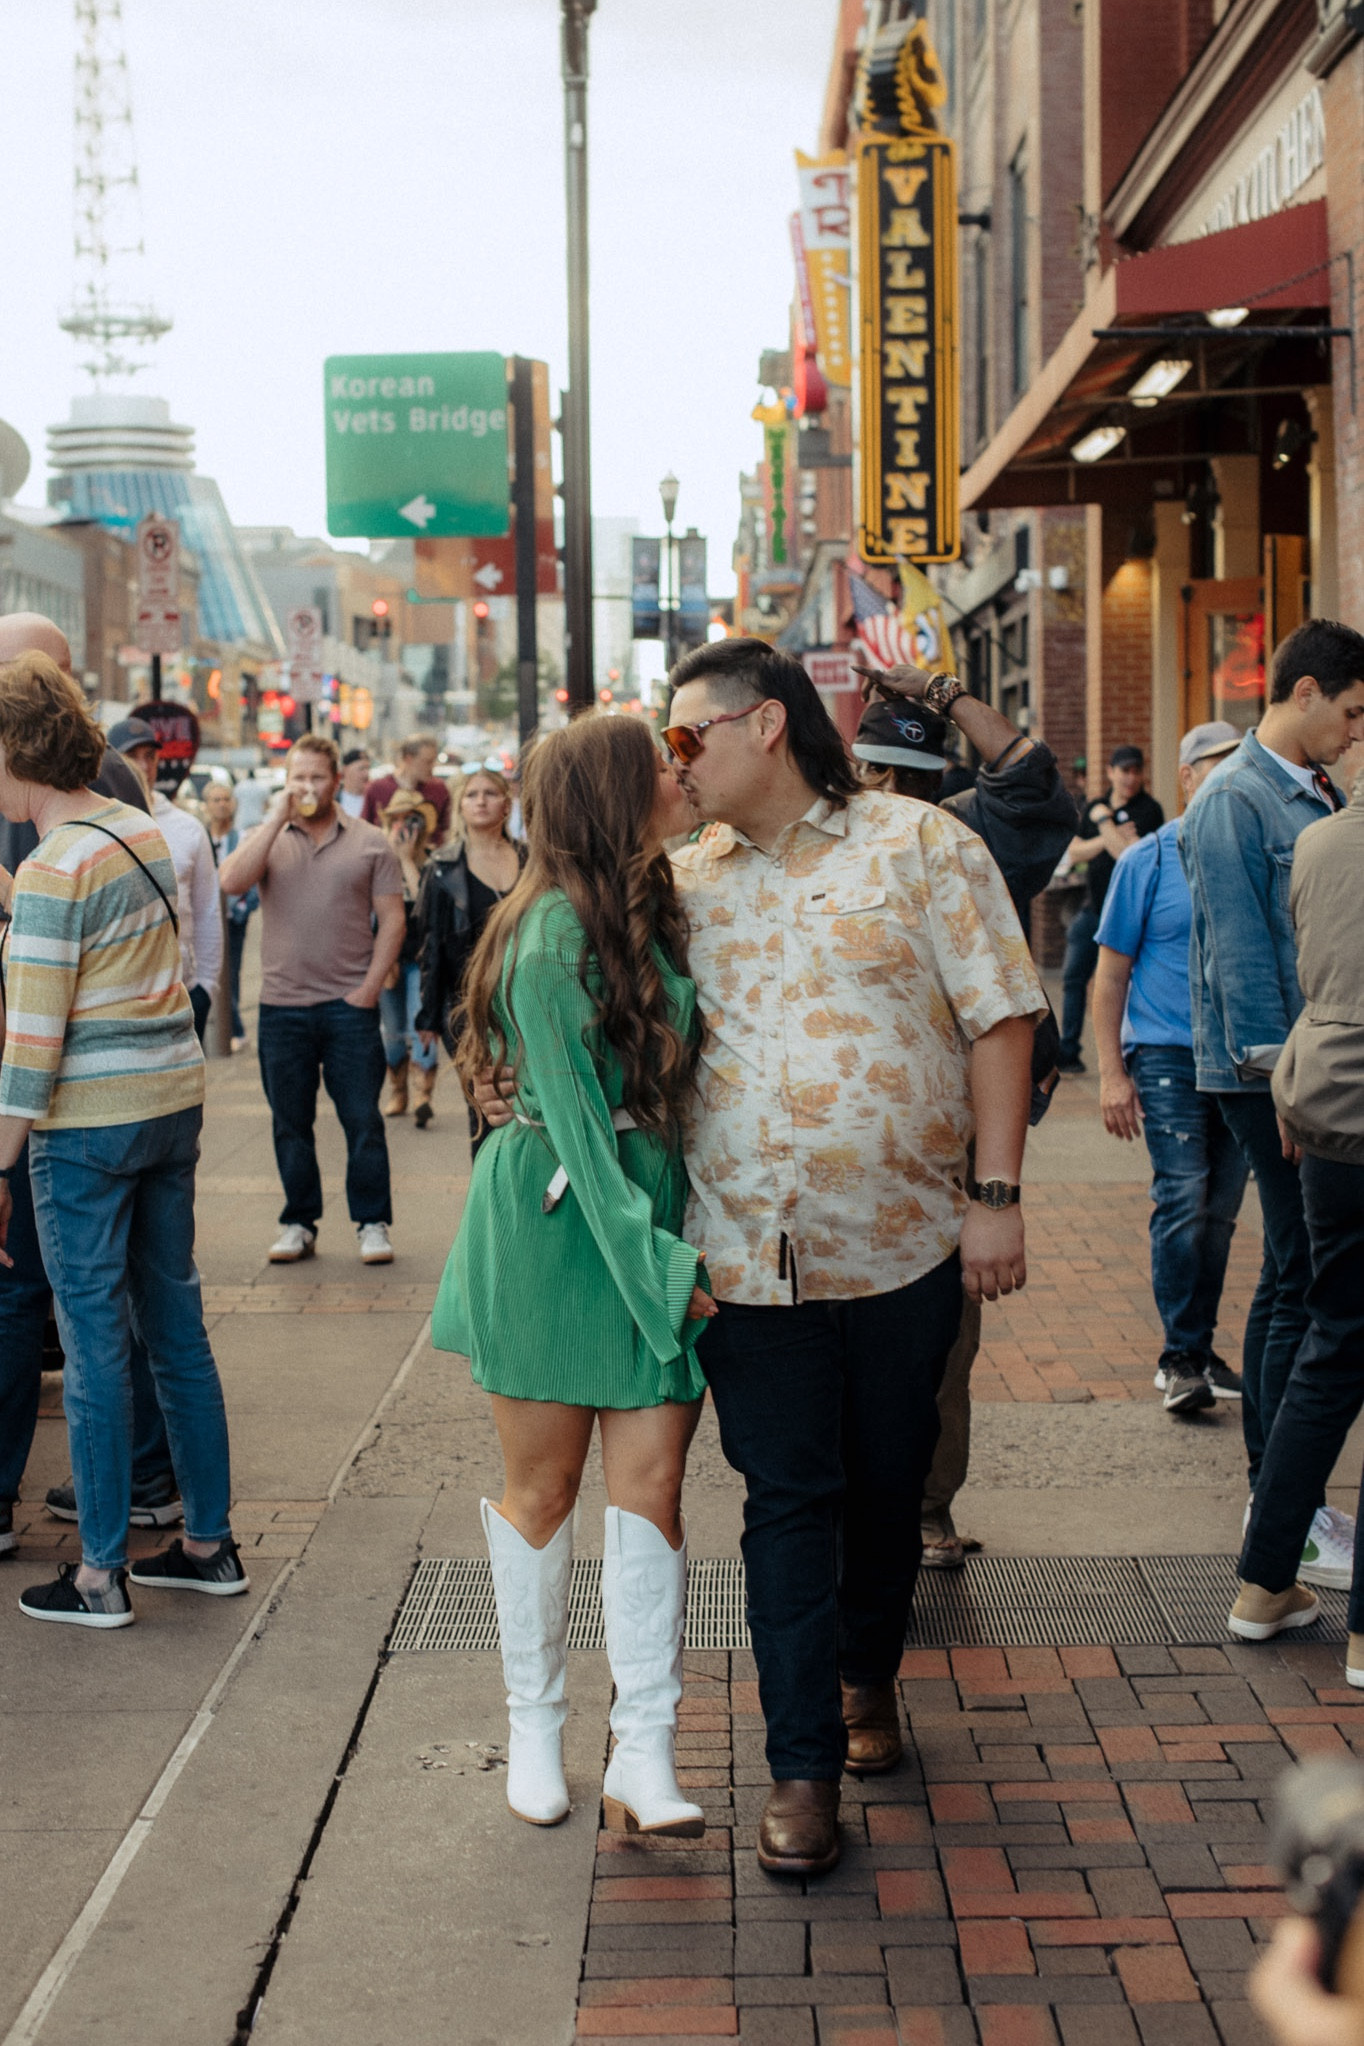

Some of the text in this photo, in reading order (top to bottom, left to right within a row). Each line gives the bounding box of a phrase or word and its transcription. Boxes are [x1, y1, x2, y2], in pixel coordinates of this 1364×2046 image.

[881, 165, 932, 555] VALENTINE
[331, 375, 436, 399] Korean
[332, 405, 506, 437] Vets Bridge
